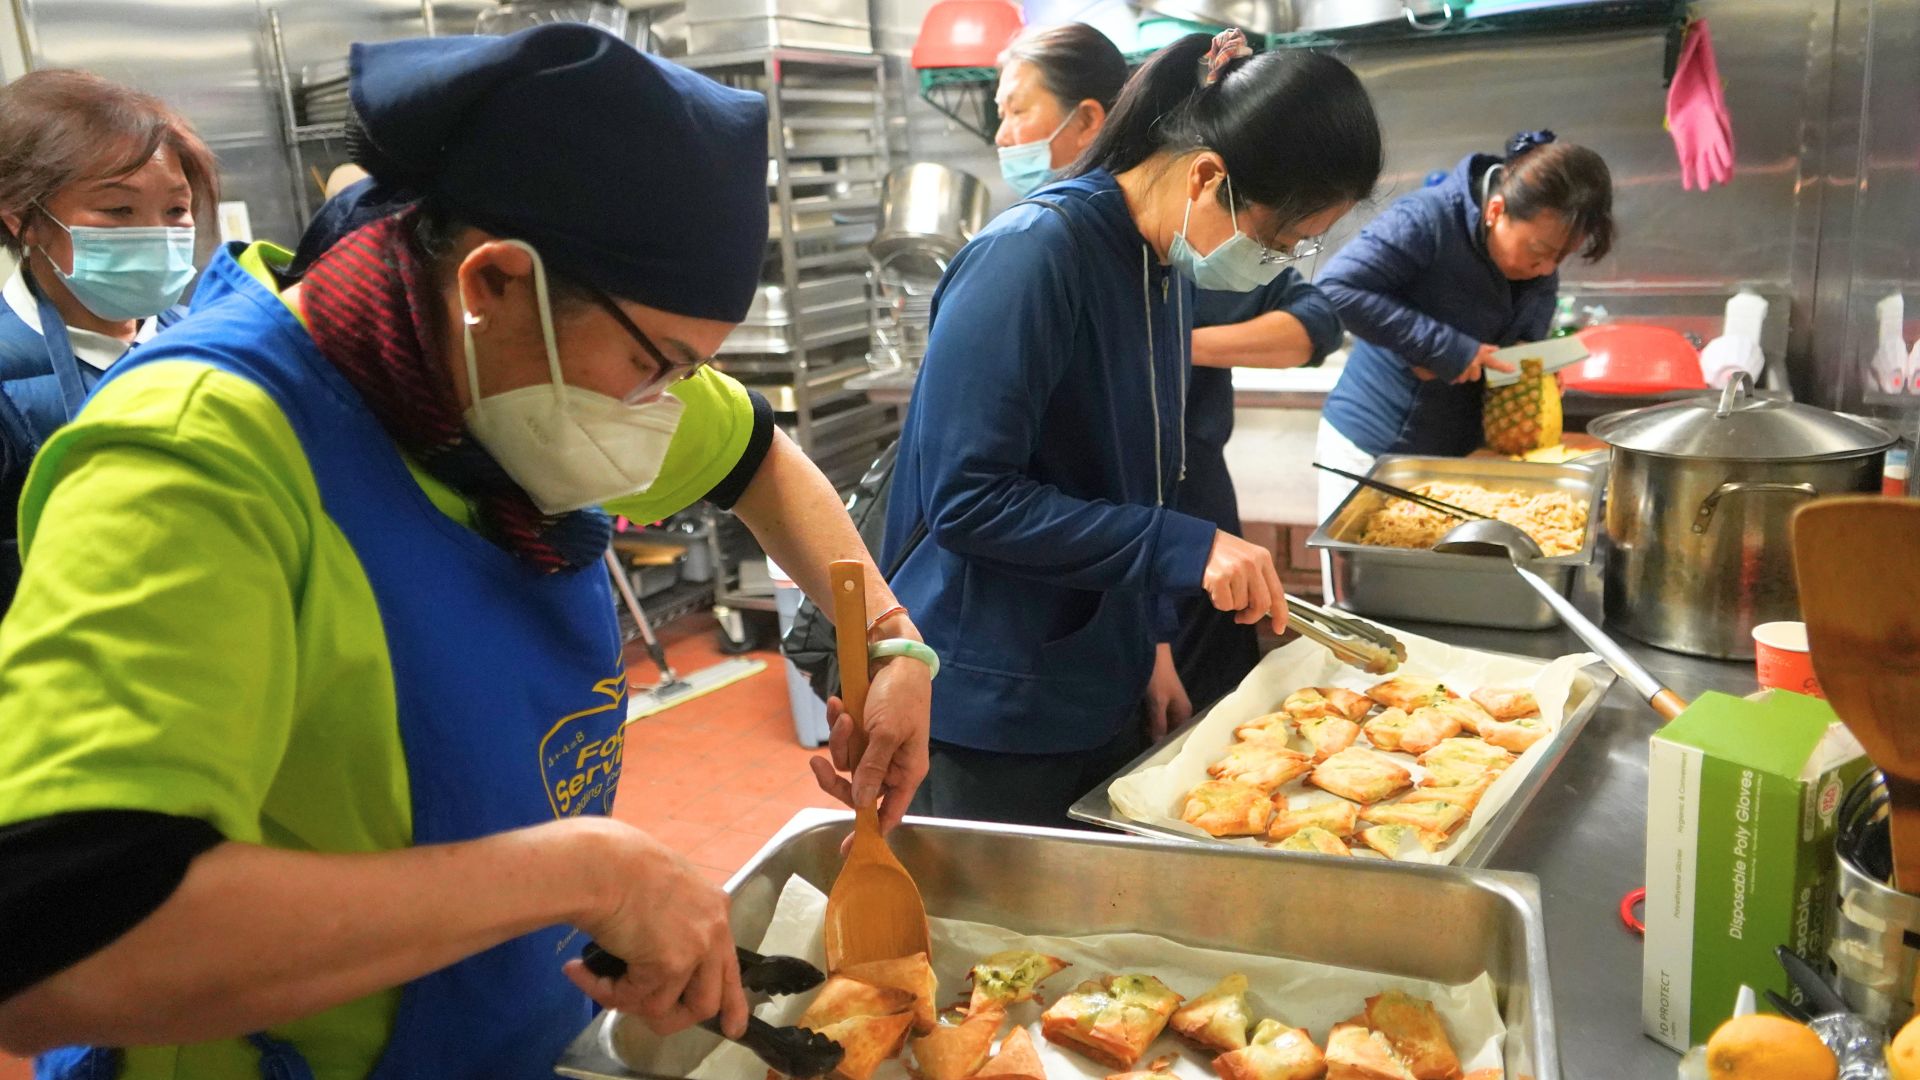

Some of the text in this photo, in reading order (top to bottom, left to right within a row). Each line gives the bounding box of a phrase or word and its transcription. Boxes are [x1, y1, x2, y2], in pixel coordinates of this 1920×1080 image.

[1729, 769, 1754, 940] Disposable Poly Gloves
[1660, 969, 1671, 1021] PROTECT
